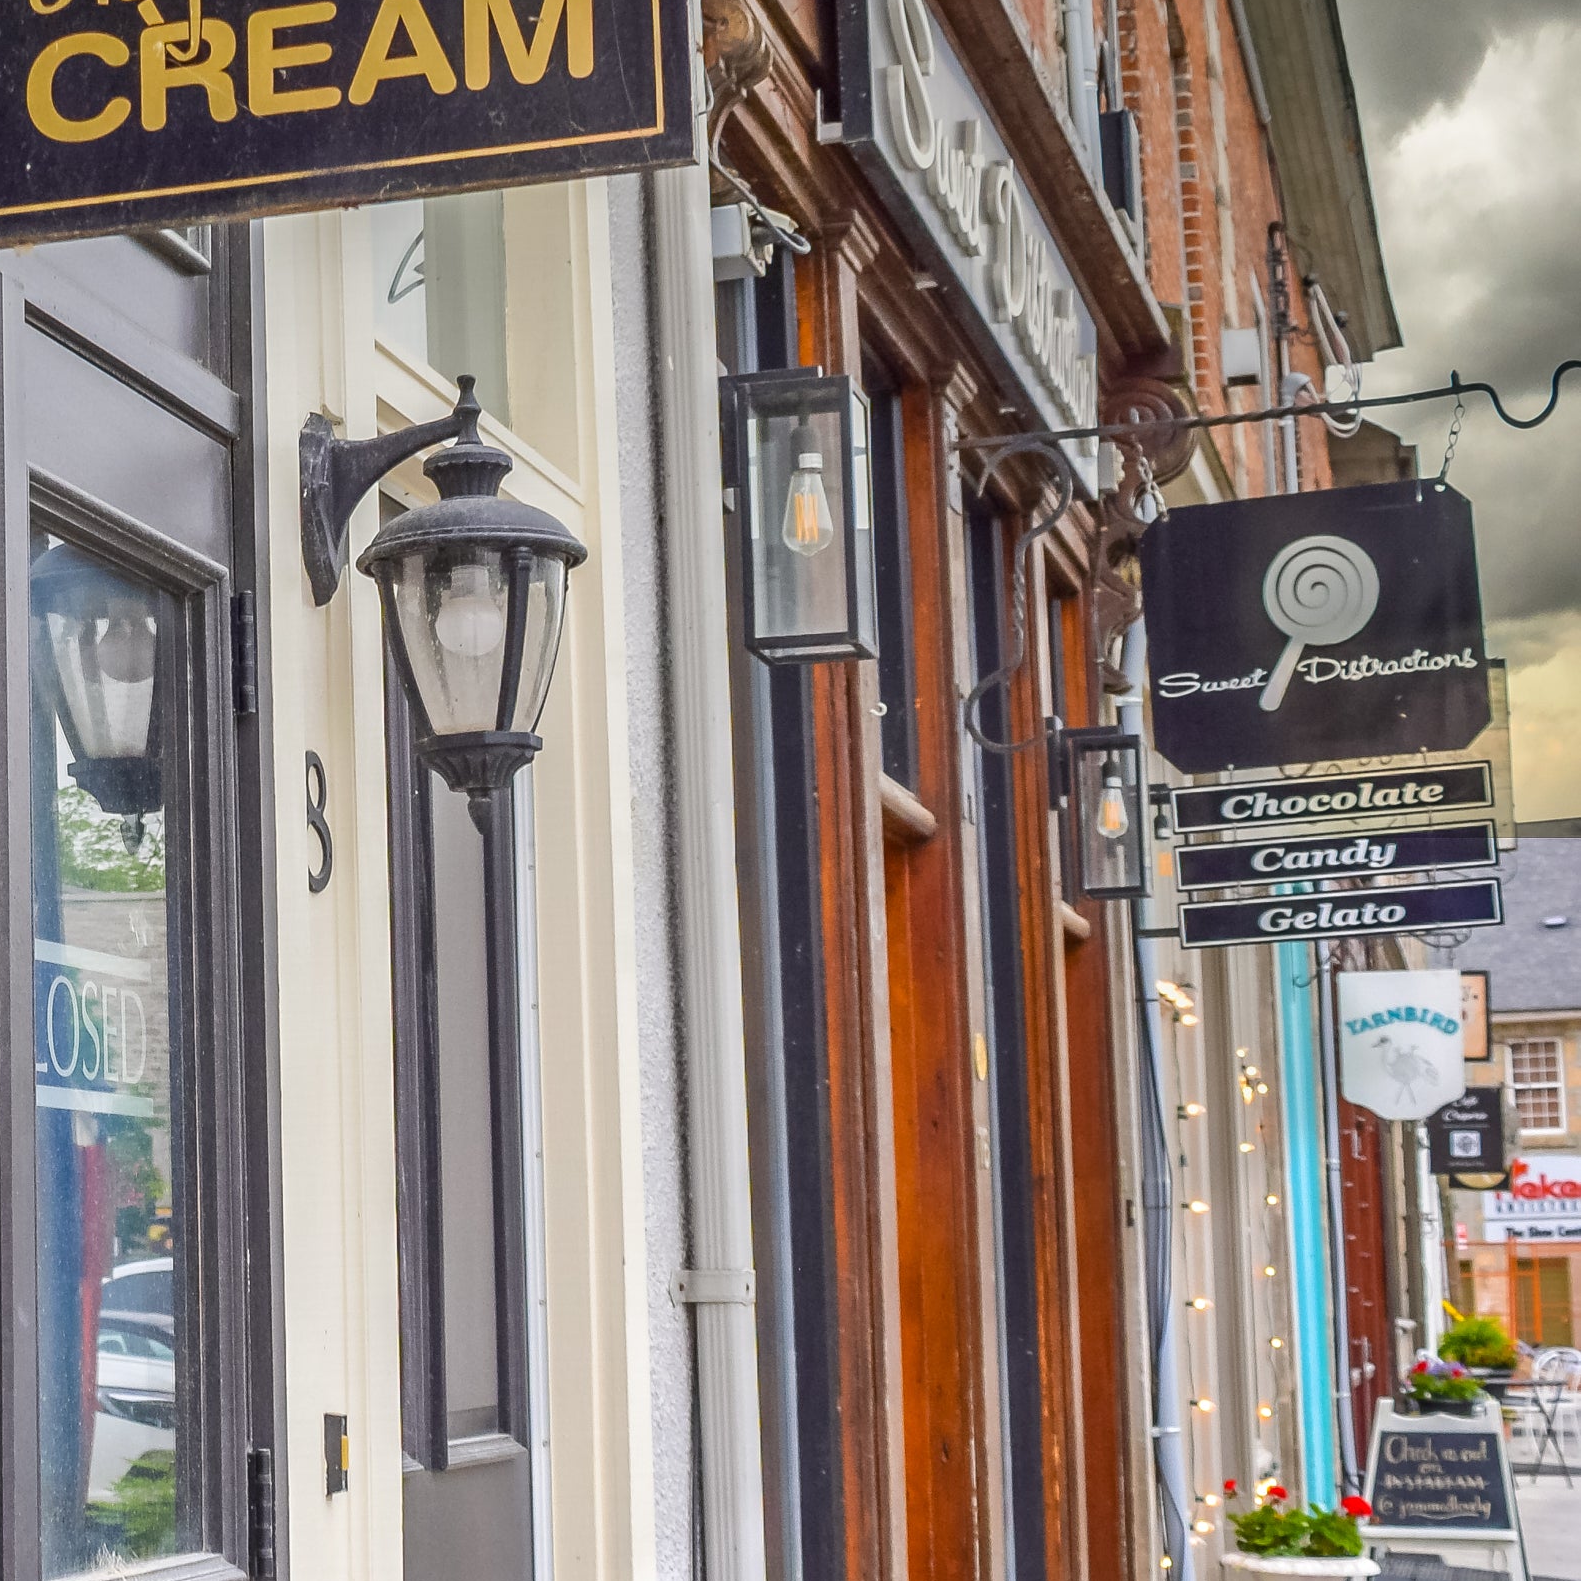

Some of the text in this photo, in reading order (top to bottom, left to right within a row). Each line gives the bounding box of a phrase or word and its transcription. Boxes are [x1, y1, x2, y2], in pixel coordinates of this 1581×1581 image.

[1159, 647, 1478, 698] Sweet Distractions
[1220, 779, 1444, 821] Chocolate
[1251, 838, 1397, 873] Candy
[1258, 902, 1406, 934] Gelato
[36, 975, 147, 1085] OSED
[1345, 1006, 1460, 1036] YARNBIRD
